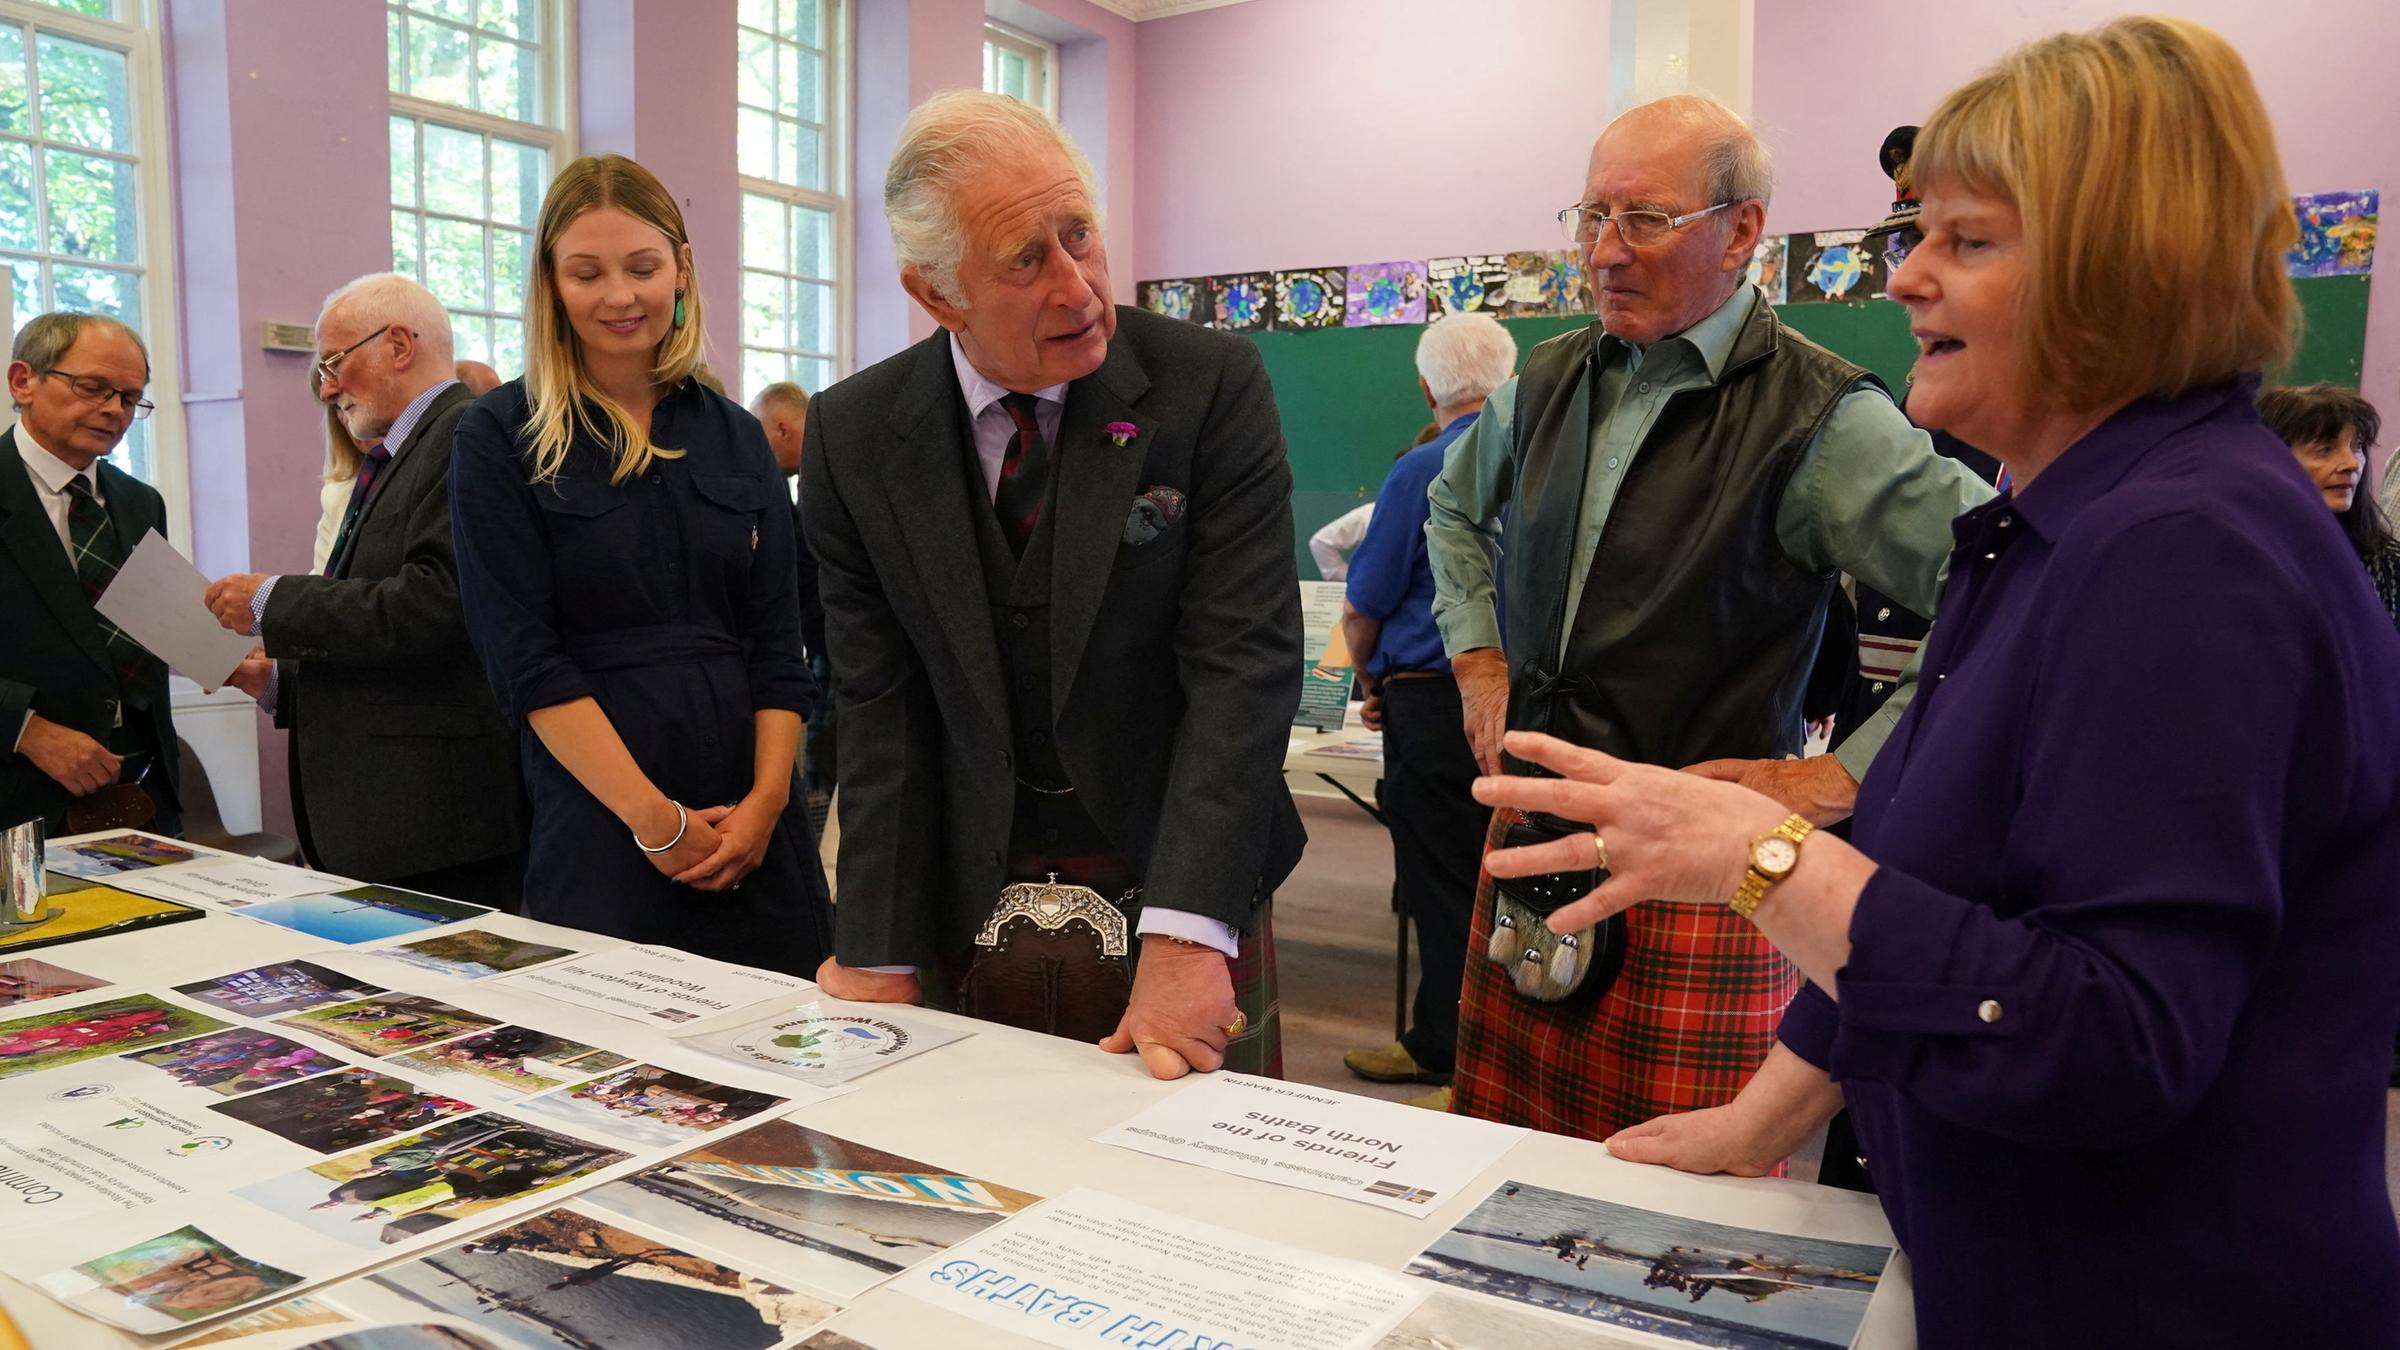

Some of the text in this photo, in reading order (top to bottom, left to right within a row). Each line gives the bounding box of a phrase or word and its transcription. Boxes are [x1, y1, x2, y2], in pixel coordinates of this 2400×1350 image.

[559, 965, 593, 976] Hill
[590, 972, 650, 991] Newton
[625, 969, 706, 993] Woodland
[668, 991, 731, 1011] Friends
[771, 1016, 908, 1057] Newtonhill Woodland
[734, 1044, 826, 1069] Friends of
[1222, 1077, 1341, 1107] JENNIFER MARTIN
[1123, 1126, 1186, 1146] Groups
[1243, 1110, 1403, 1154] North Baths
[1210, 1120, 1397, 1170] Friends of the
[1273, 1160, 1365, 1188] Caithness
[0, 1165, 64, 1205] Comm
[742, 1164, 1004, 1209] NORTH
[1043, 1215, 1073, 1226] water
[1053, 1209, 1083, 1220] white
[1073, 1224, 1096, 1233] cold
[1095, 1231, 1121, 1240] keen
[1114, 1226, 1143, 1237] helps
[1165, 1242, 1193, 1253] team
[1170, 1234, 1211, 1249] upkeep
[999, 1246, 1048, 1263] originally
[1041, 1250, 1067, 1260] pool
[1140, 1244, 1170, 1255] Nurse
[1068, 1258, 1101, 1270] public
[1087, 1256, 1112, 1265] with
[1172, 1253, 1214, 1268] Practice
[1228, 1259, 1275, 1274] member
[1067, 1269, 1099, 1280] which
[1117, 1264, 1145, 1274] since
[1214, 1265, 1253, 1278] retired
[1110, 1272, 1133, 1281] into
[1151, 1274, 1174, 1282] ever
[1253, 1274, 1301, 1290] recently
[1099, 1279, 1130, 1290] baths
[1135, 1279, 1202, 1301] transformed
[930, 1260, 1110, 1331] BATHS
[1204, 1289, 1246, 1303] regular
[1169, 1310, 1203, 1321] Baths
[1229, 1307, 1276, 1322] harbour
[1205, 1320, 1241, 1332] North
